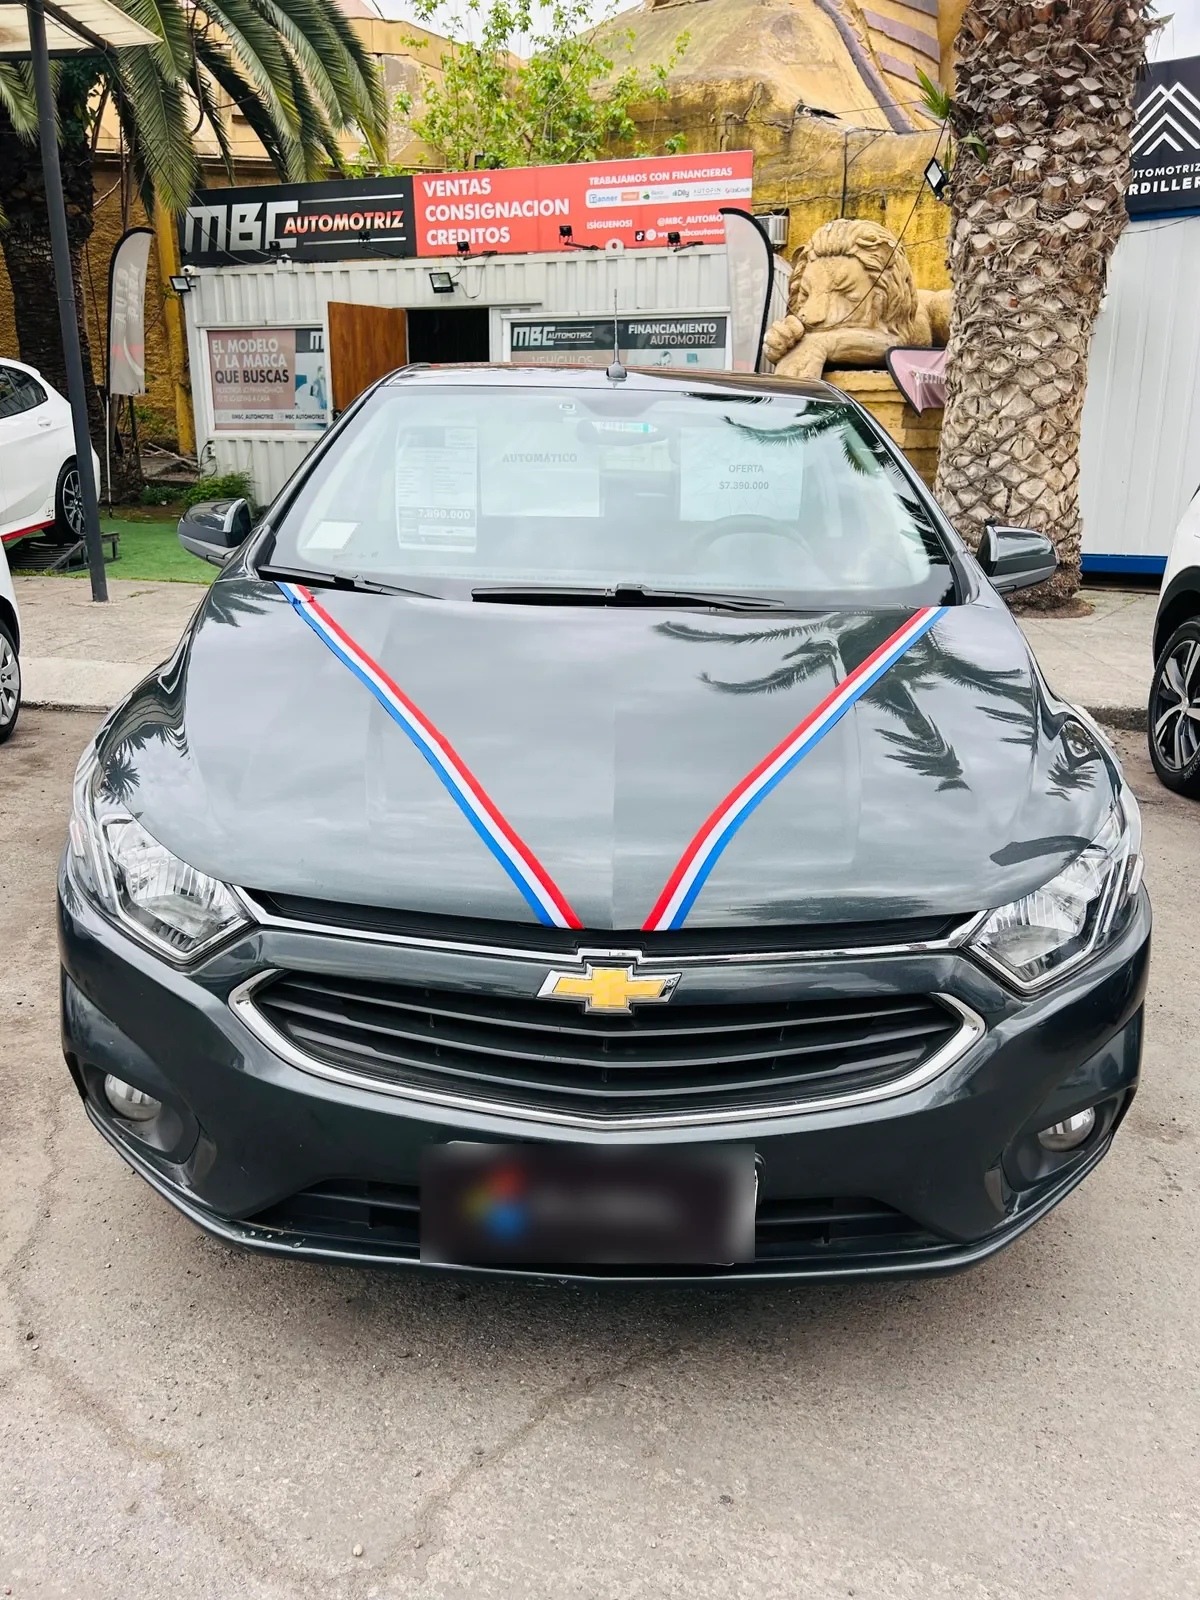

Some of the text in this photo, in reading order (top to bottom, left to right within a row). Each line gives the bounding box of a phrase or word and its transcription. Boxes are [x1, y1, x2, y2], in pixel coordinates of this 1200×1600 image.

[589, 168, 732, 185] TRABAJAMOS CON FINANCIERAS
[423, 178, 491, 197] VENTAS
[1124, 176, 1200, 195] RDILLER
[426, 198, 569, 221] CONSIGNACION
[184, 200, 404, 252] MBC AUTOMOTRIZ
[657, 214, 723, 226] @MBC_AUTOMO
[427, 227, 510, 245] CREDITOS
[513, 326, 555, 346] MBC
[628, 323, 716, 334] FINANCIAMIENTO
[212, 339, 278, 353] EL MODELO
[650, 335, 716, 344] AUTOMOTRIZ
[214, 354, 287, 368] Y LA MARCA
[215, 370, 289, 384] QUE BUSCAS
[719, 481, 769, 490] $7.390.000
